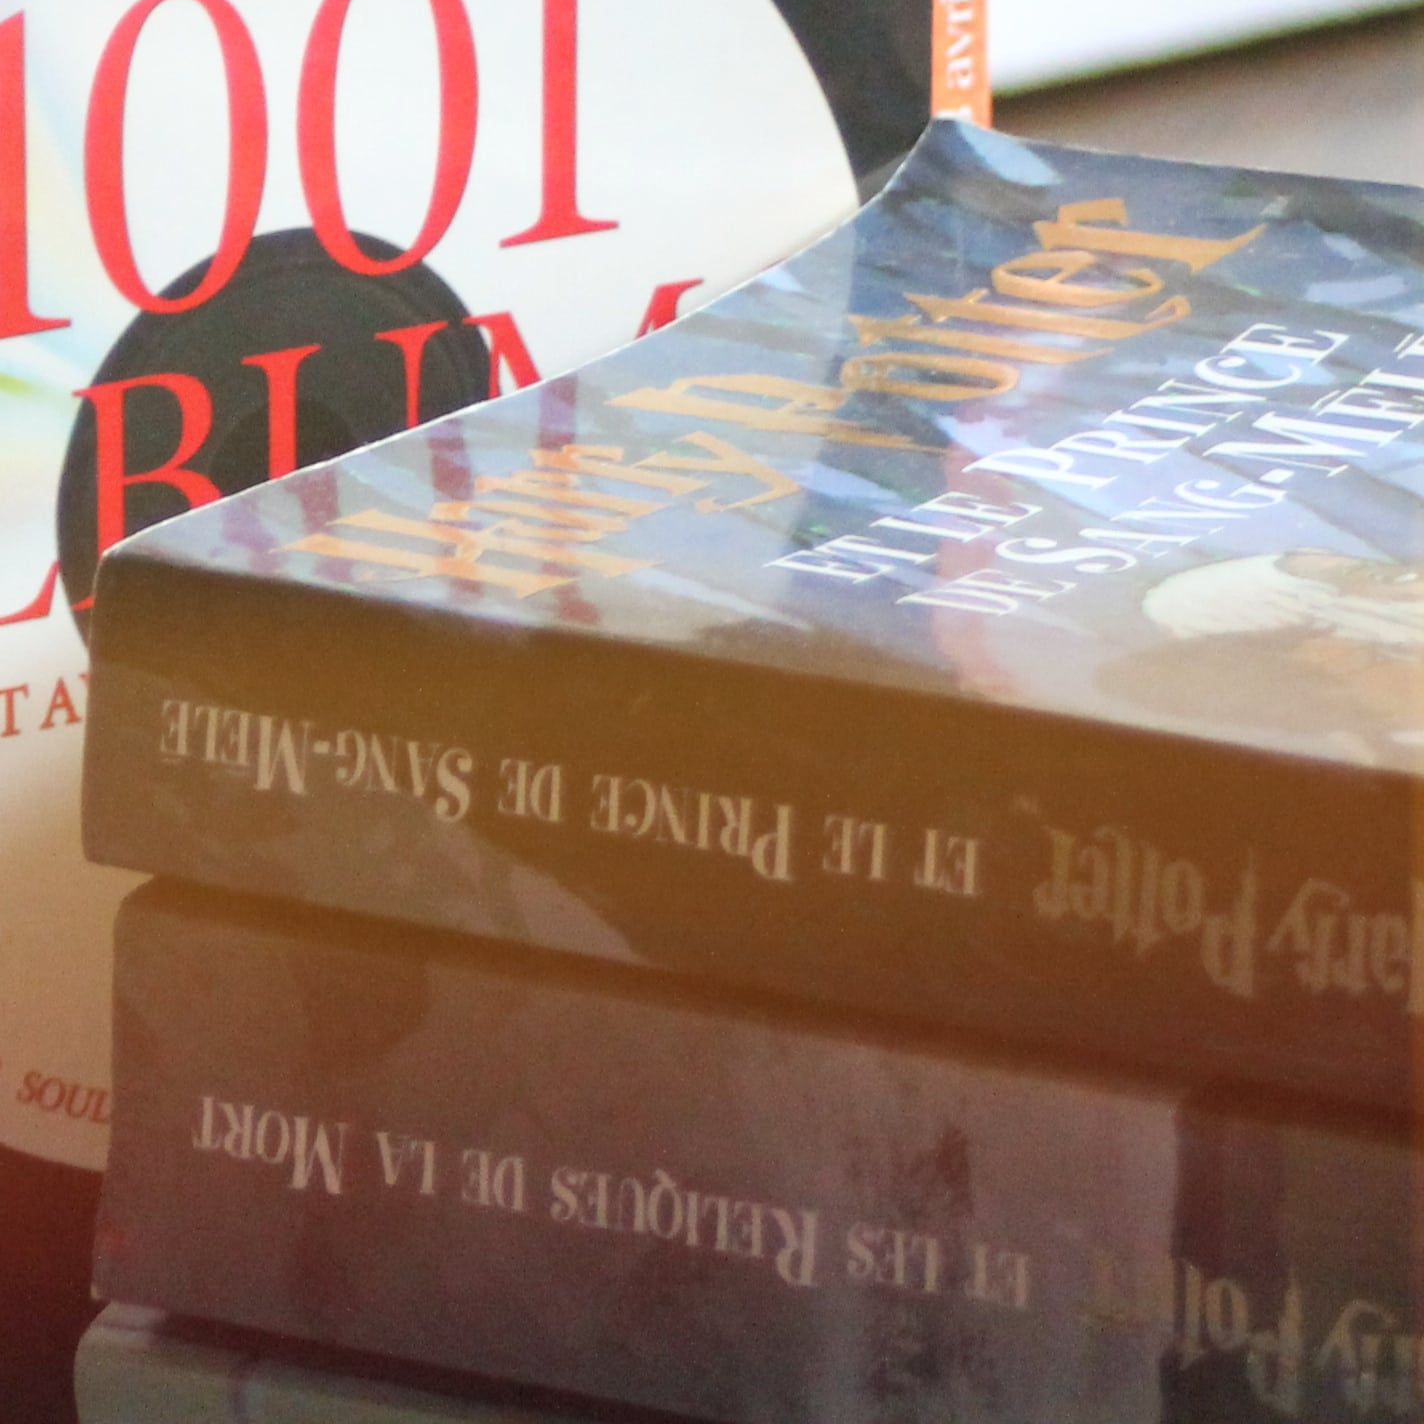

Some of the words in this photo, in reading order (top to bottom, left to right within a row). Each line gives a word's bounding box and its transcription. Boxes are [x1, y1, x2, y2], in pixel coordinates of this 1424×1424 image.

[604, 198, 1267, 453] Potter
[763, 534, 937, 585] ET
[869, 490, 1043, 544] LE
[963, 322, 1350, 490] PRINCE
[896, 568, 1078, 617] DE
[498, 758, 563, 823] DE
[591, 774, 793, 880] PRINCE
[823, 814, 887, 880] LE
[915, 829, 980, 896] ET
[1033, 824, 1254, 999] Potter
[1266, 876, 1424, 1001] arry
[16, 1069, 111, 1125] SOUL
[193, 1095, 350, 1196] MORT
[376, 1130, 437, 1196] LA
[463, 1148, 525, 1212] DE
[552, 1165, 820, 1288] RELIQUES
[847, 1224, 942, 1295] LES
[966, 1242, 1031, 1312] ET
